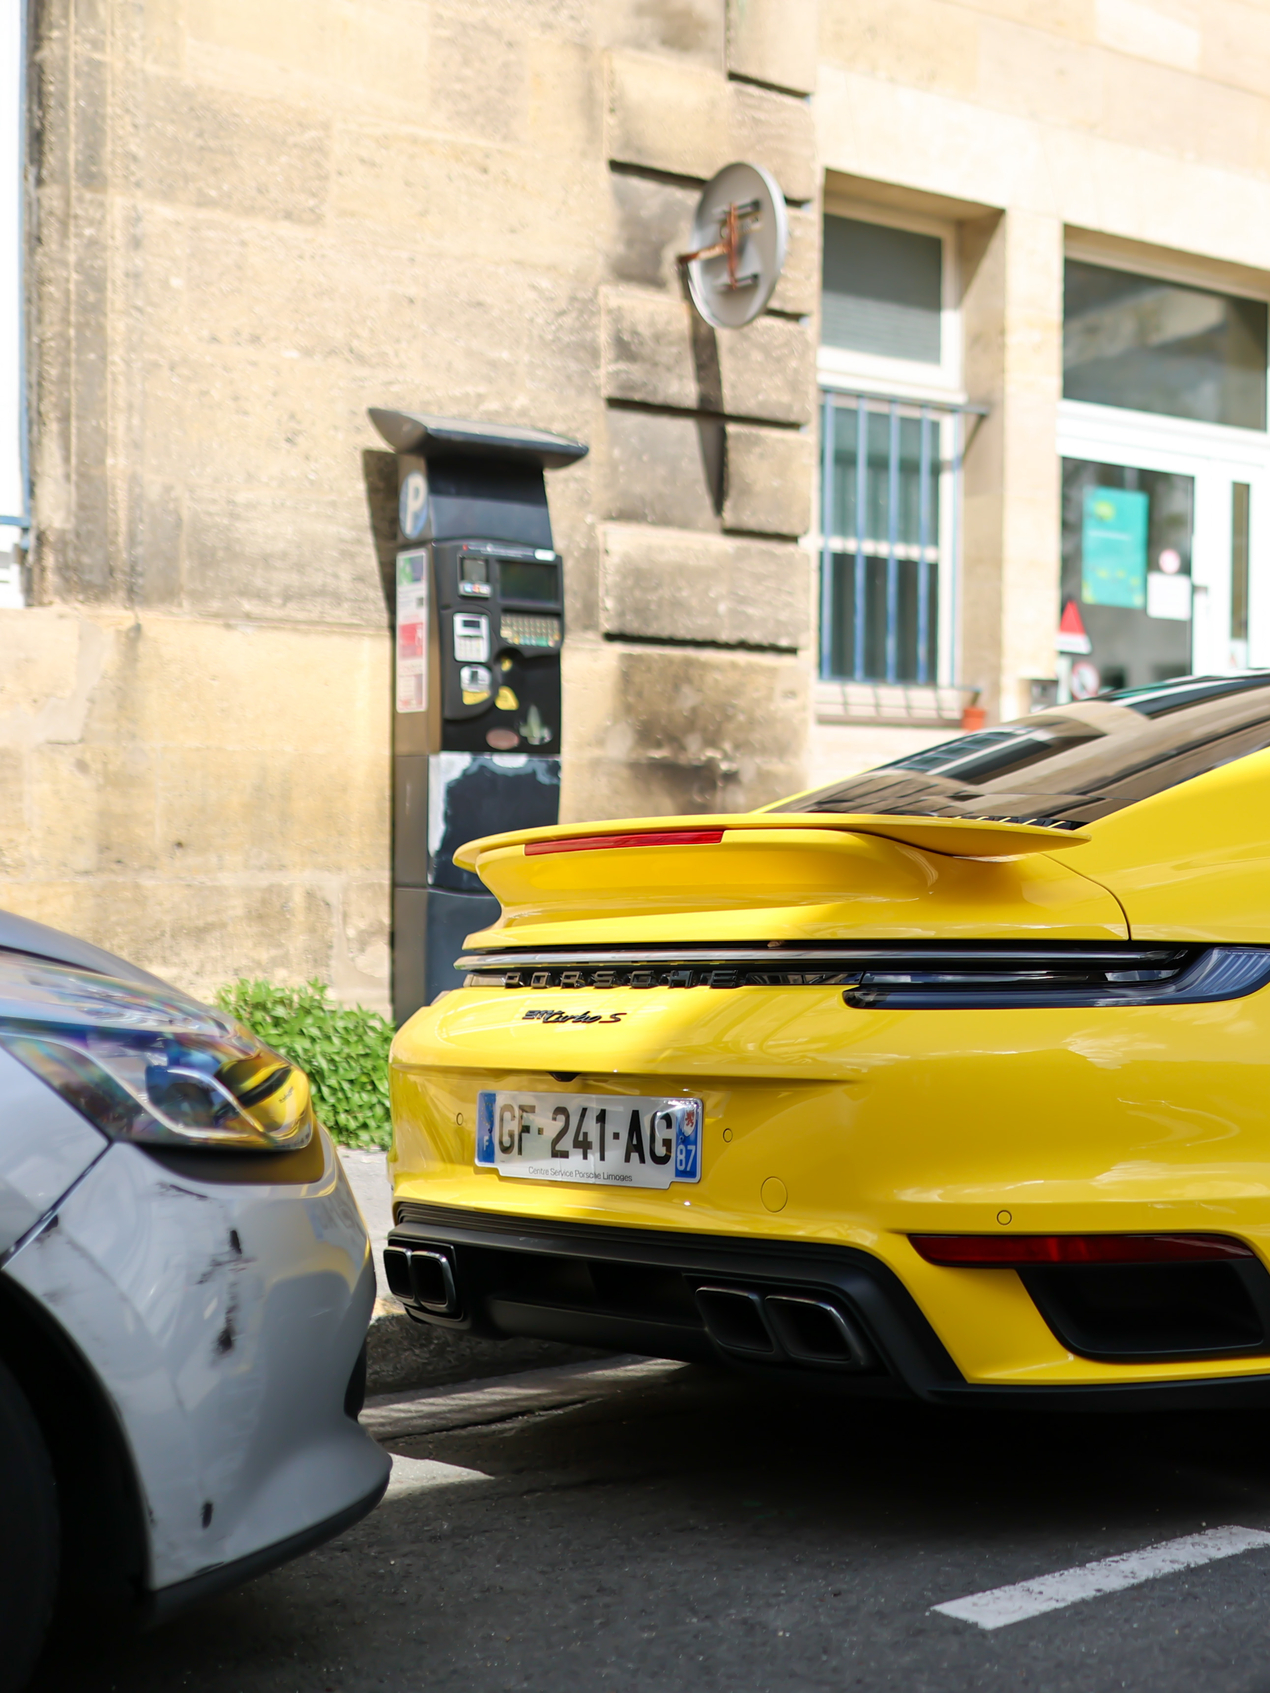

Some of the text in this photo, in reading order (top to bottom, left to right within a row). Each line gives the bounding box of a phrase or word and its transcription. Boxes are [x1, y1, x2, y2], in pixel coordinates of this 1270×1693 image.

[405, 474, 427, 535] P
[504, 970, 738, 989] PORSCHE
[598, 1012, 627, 1023] S
[483, 1135, 490, 1151] F
[498, 1103, 673, 1166] GF-241-AG
[675, 1145, 696, 1172] 87
[528, 1165, 633, 1183] Centre Service Porsche Limoges
